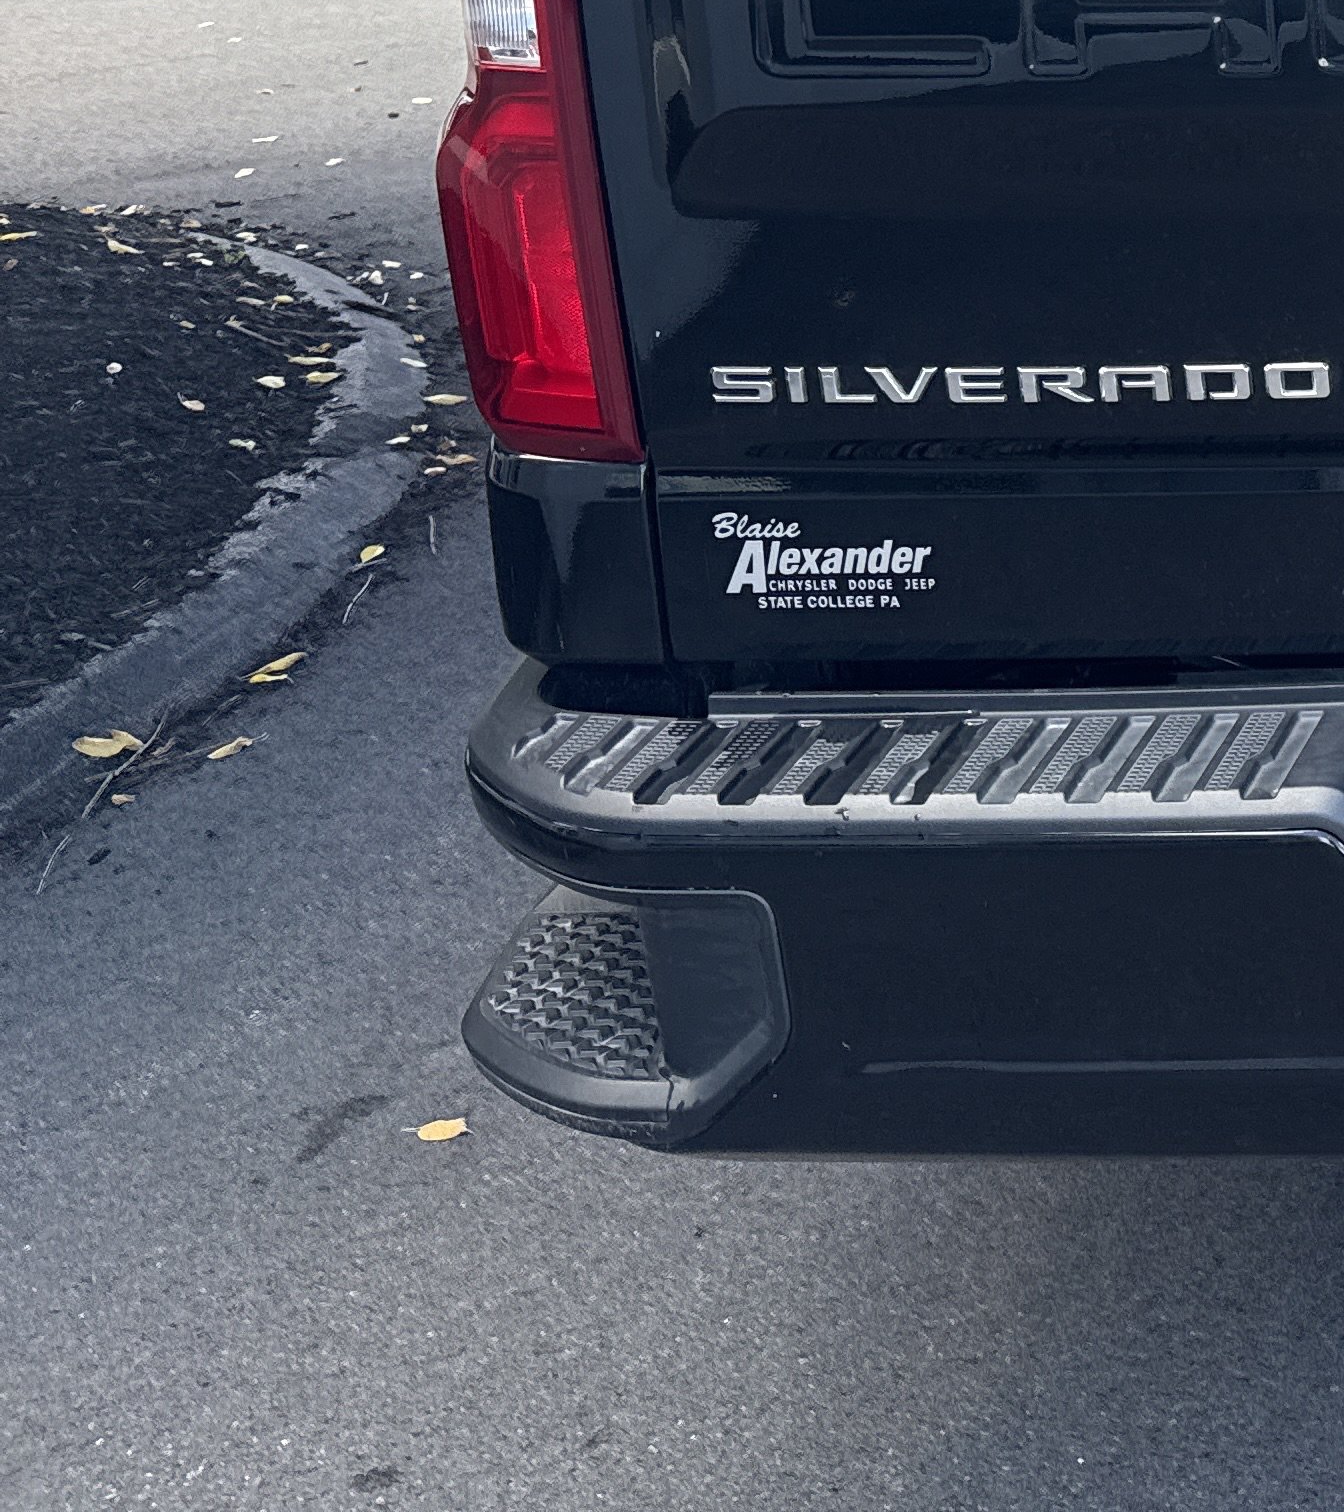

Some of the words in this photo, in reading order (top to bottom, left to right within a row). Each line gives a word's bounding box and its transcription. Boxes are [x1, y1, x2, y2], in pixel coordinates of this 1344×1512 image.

[710, 362, 1331, 404] SILVERADO
[711, 512, 801, 539] Blaise
[726, 539, 932, 594] Alexander
[768, 579, 838, 592] CHRYSLER
[848, 579, 894, 591] DODGE
[904, 578, 936, 591] JEEP
[758, 596, 804, 609] STATE
[807, 595, 875, 608] COLLEGE
[880, 595, 901, 608] PA
